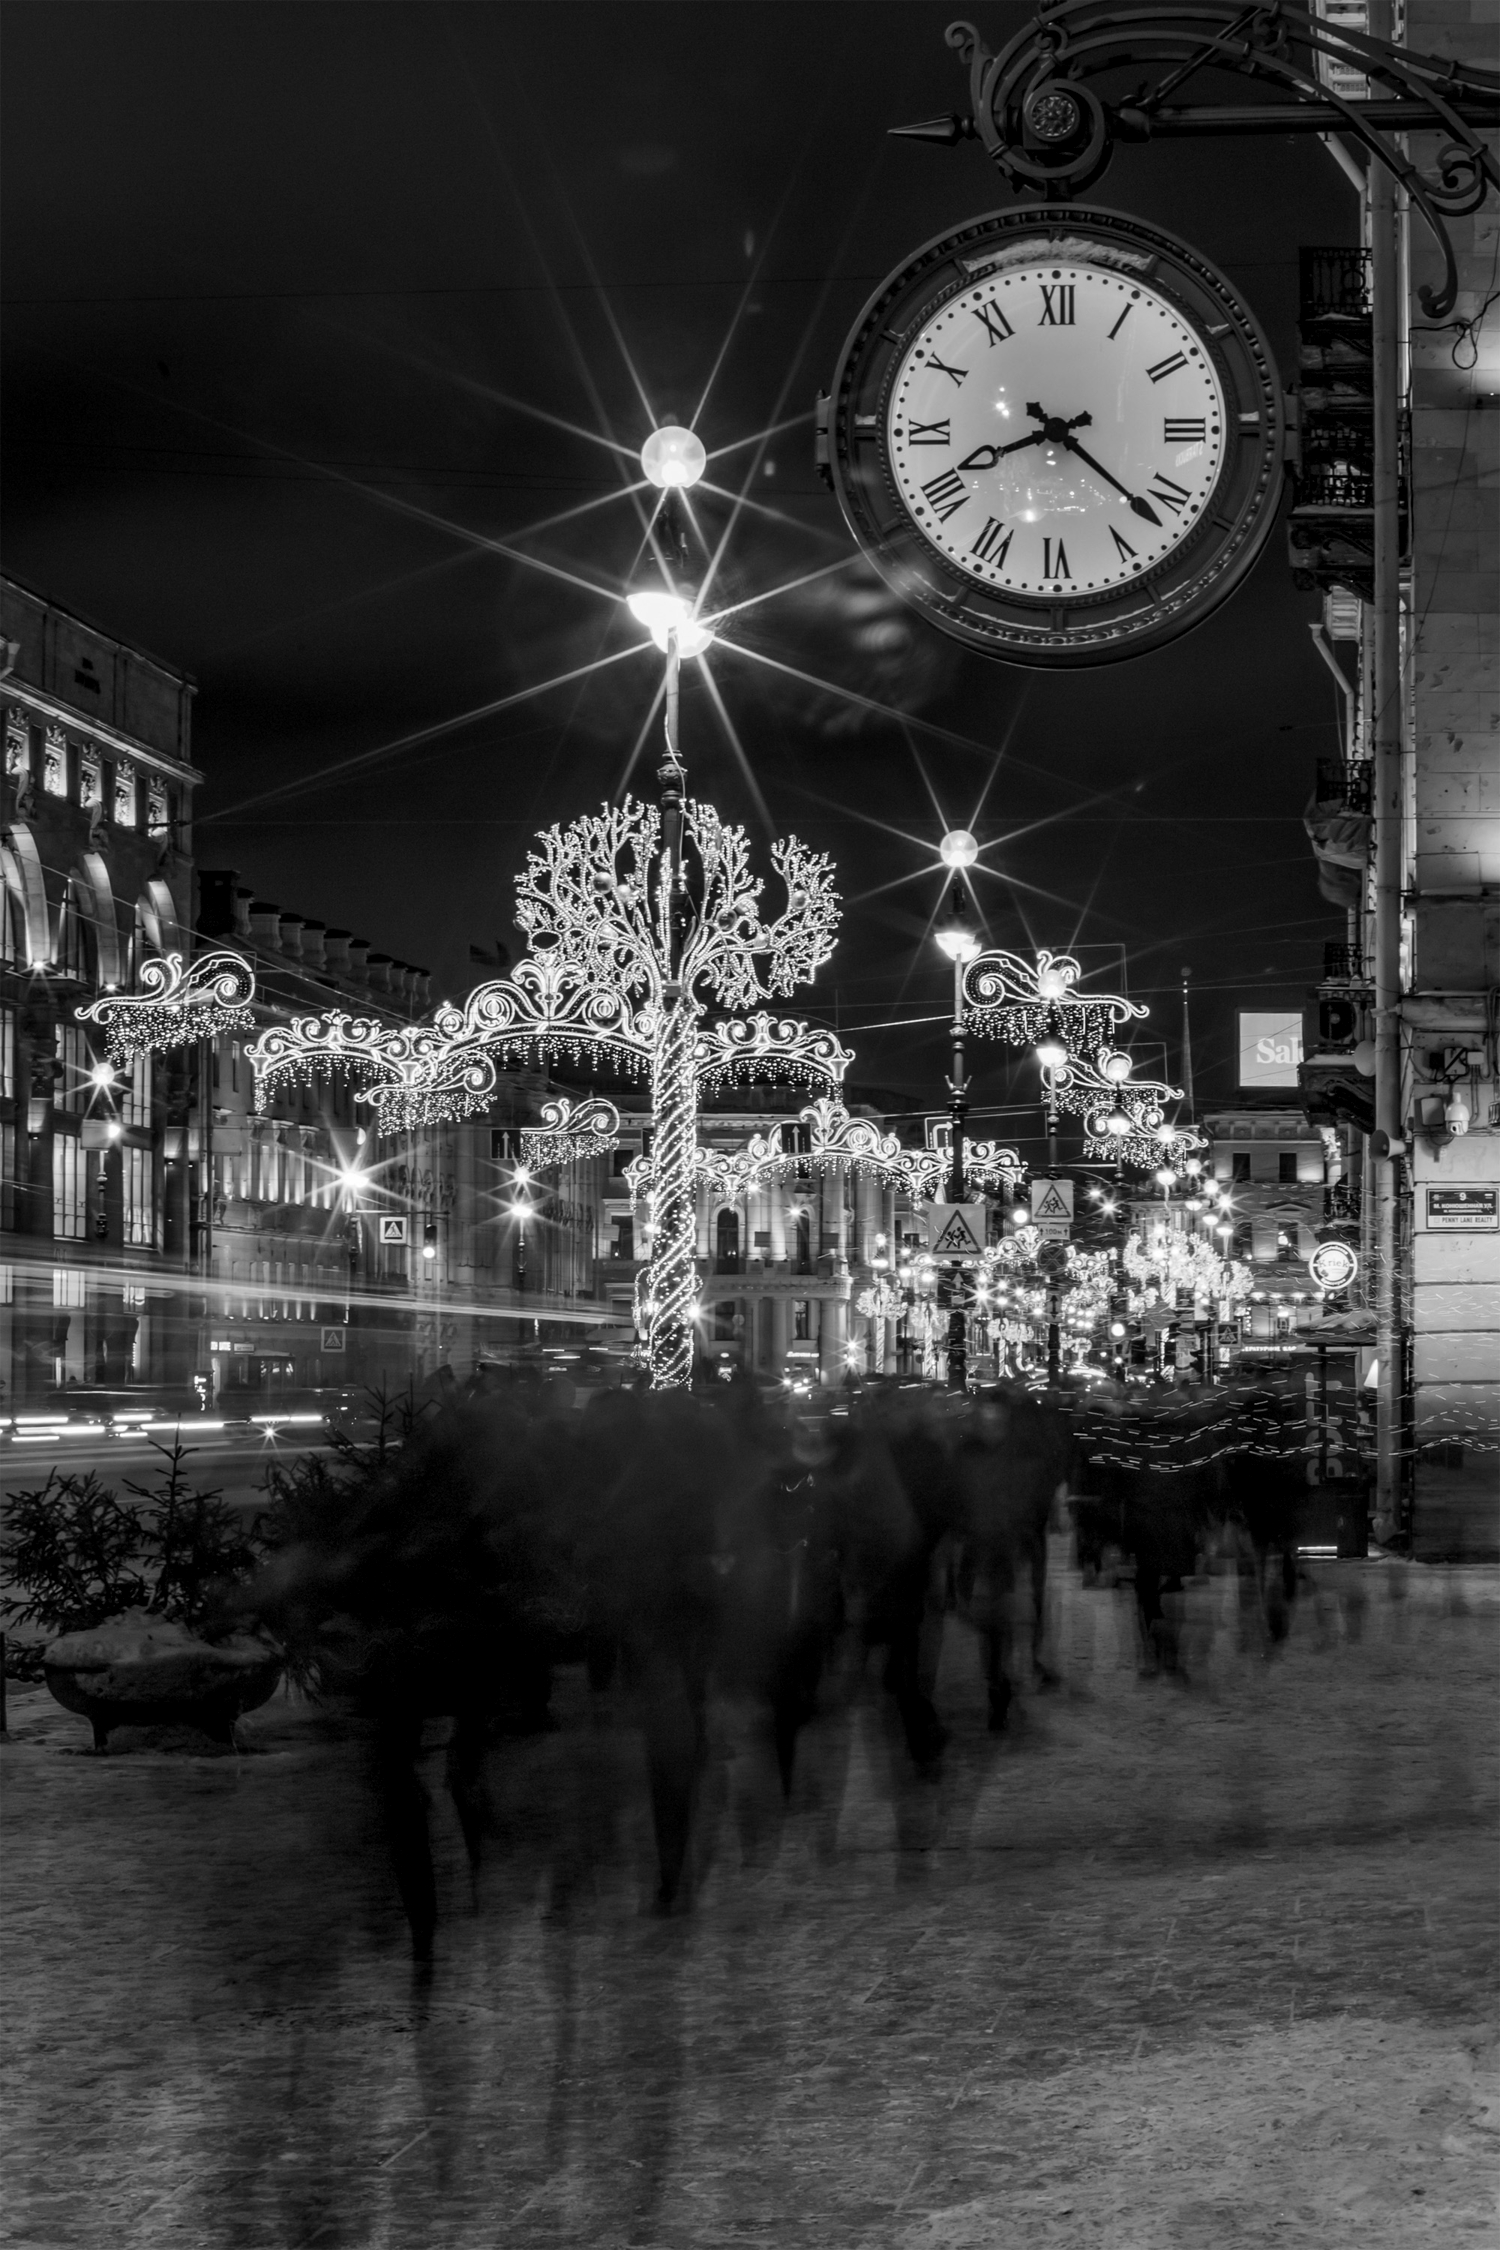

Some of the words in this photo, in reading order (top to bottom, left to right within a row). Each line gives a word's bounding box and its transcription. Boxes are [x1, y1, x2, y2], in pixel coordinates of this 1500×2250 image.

[971, 298, 1016, 347] XI
[1037, 284, 1076, 325] XII
[1107, 303, 1134, 340] I
[924, 352, 969, 388] X
[1145, 350, 1190, 384] II
[908, 418, 951, 446] IX
[1164, 417, 1206, 443] III
[920, 467, 971, 523] VIII
[1146, 472, 1193, 517] IV
[969, 516, 1014, 571] VII
[1042, 537, 1072, 579] VI
[1108, 524, 1139, 564] V
[1257, 1037, 1304, 1064] Sal
[1459, 1192, 1467, 1201] 9
[1317, 1258, 1350, 1268] Kriek
